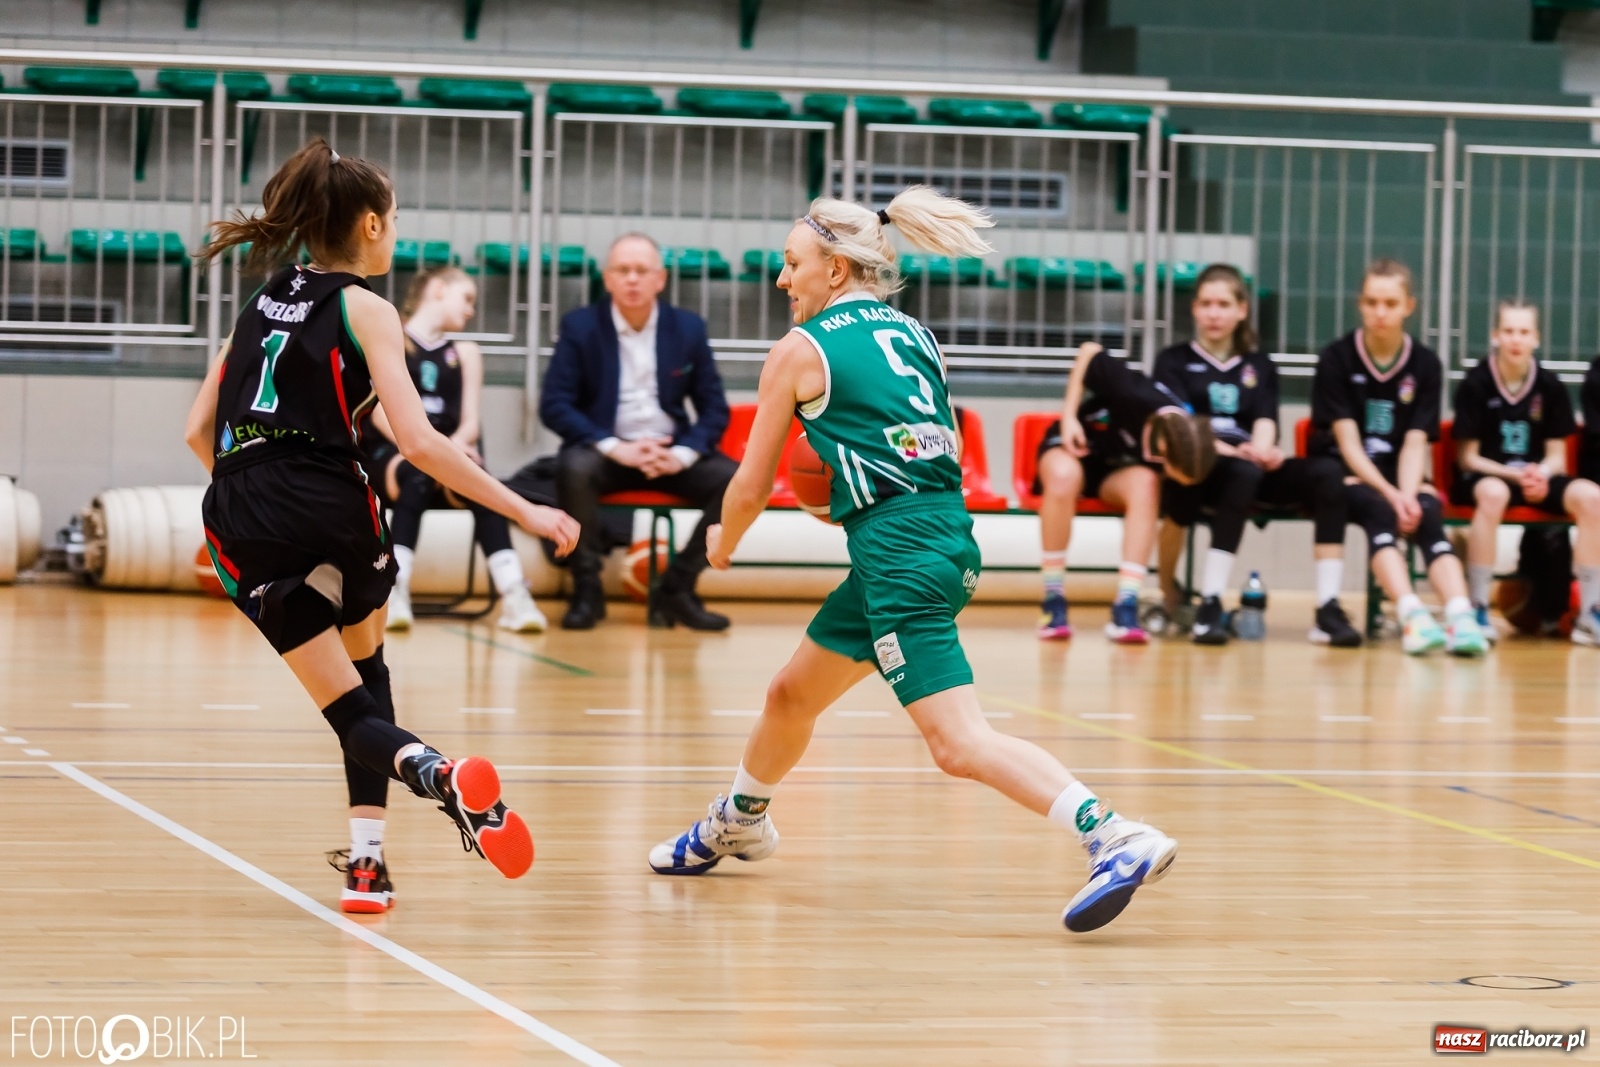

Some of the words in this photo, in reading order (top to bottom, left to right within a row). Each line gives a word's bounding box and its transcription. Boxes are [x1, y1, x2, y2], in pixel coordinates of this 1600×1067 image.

[819, 311, 858, 333] RKK
[250, 329, 291, 414] 1
[872, 328, 937, 416] 5
